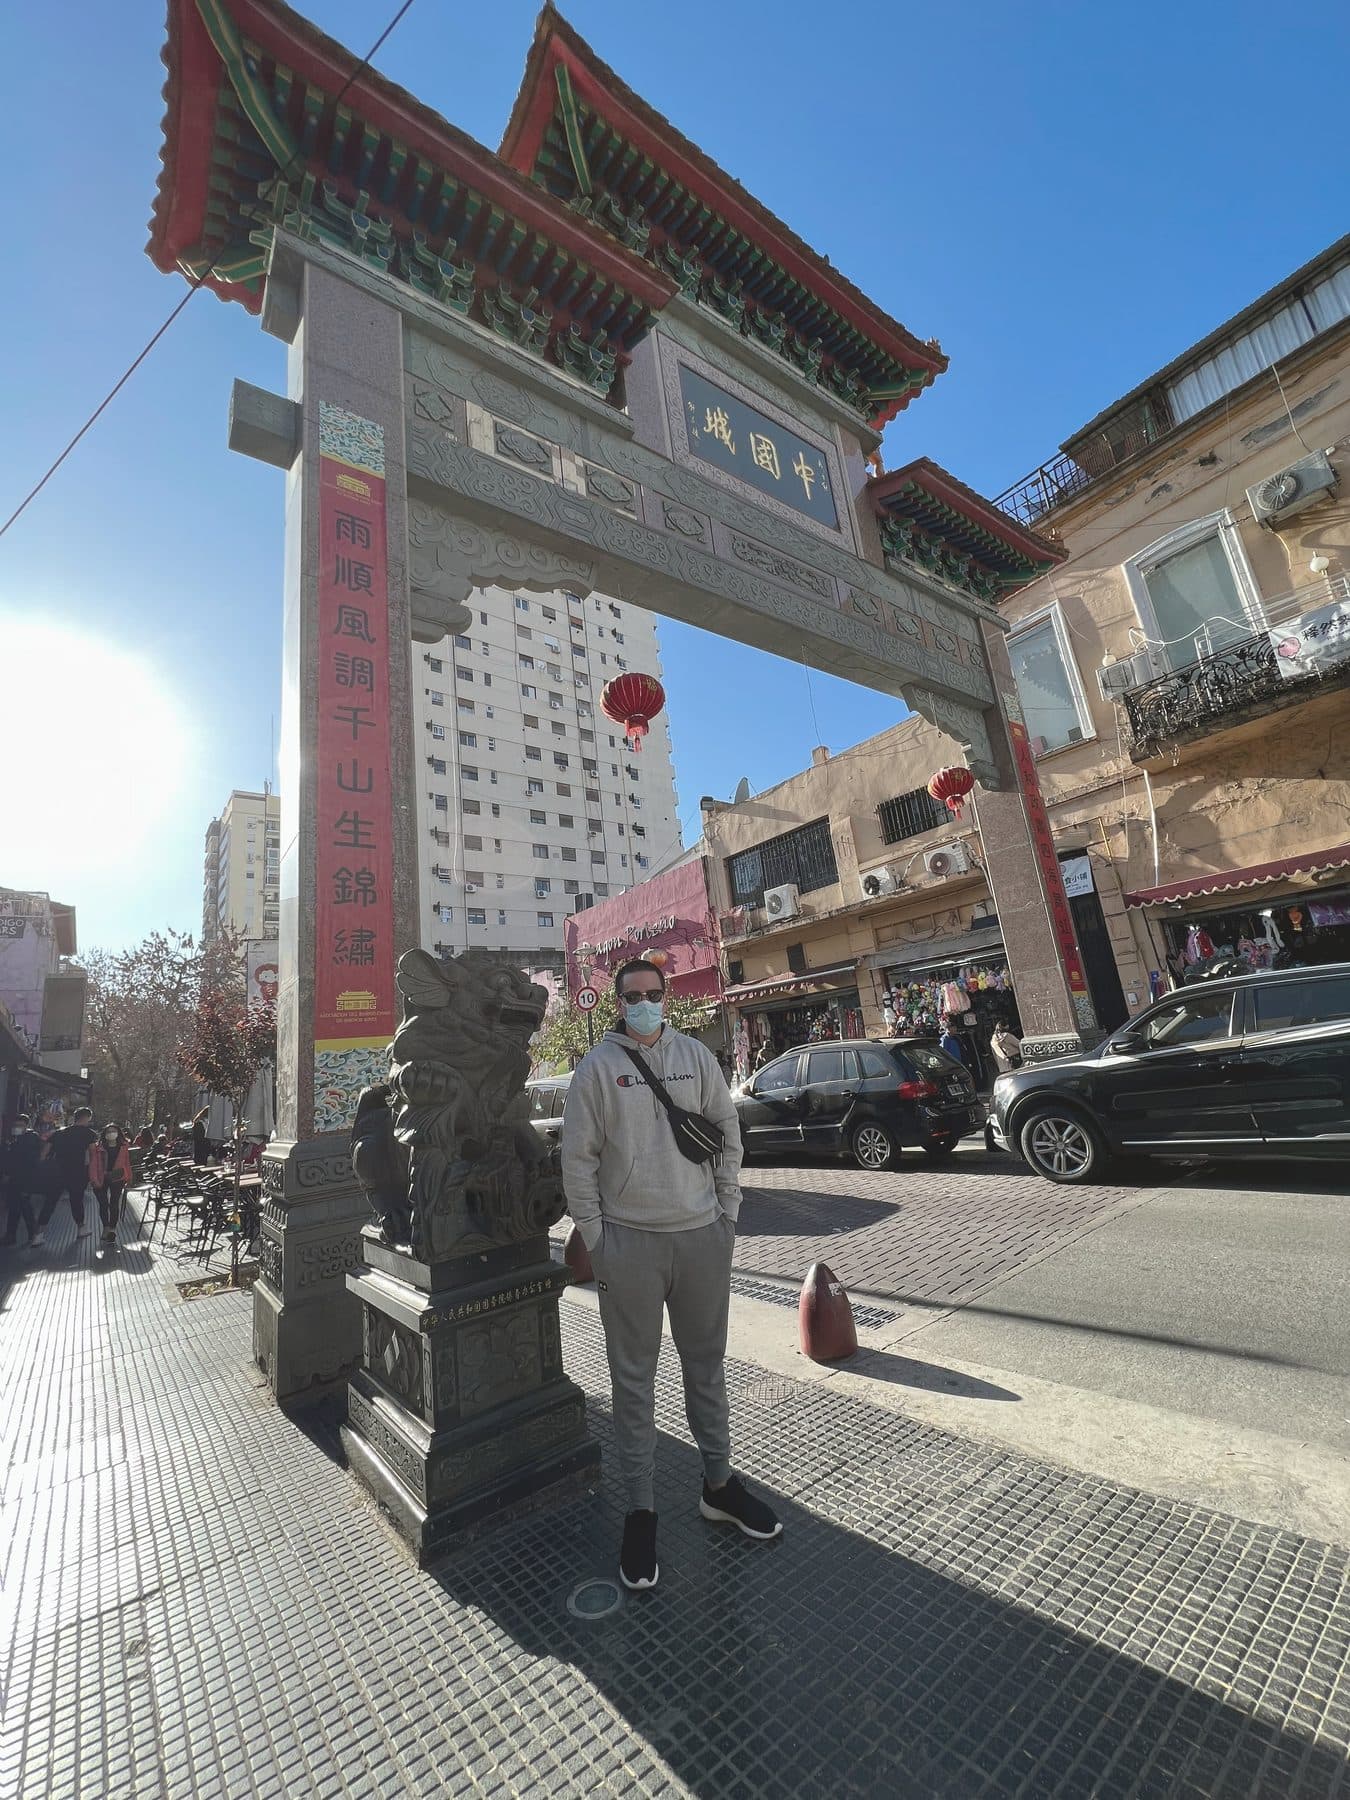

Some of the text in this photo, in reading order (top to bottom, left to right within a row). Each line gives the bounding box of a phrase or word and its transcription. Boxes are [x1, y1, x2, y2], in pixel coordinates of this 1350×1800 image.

[704, 406, 815, 501] 中國城
[580, 993, 594, 1005] 10
